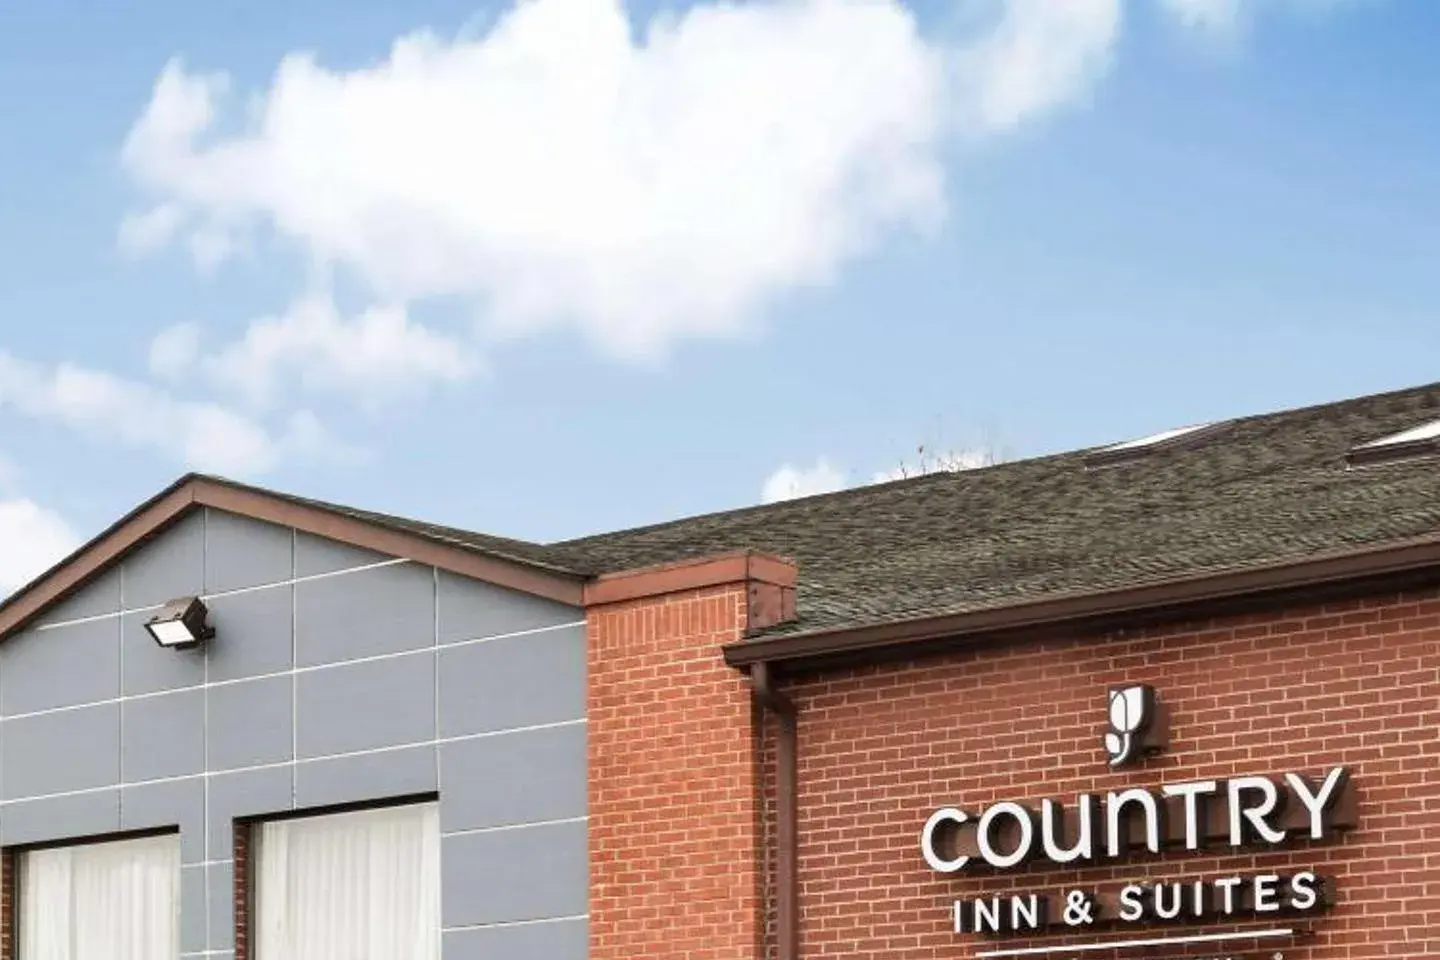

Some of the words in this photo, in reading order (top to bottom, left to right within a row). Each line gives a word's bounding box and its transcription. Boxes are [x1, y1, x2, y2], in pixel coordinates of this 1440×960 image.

[953, 894, 1039, 933] INN
[1063, 889, 1094, 926] &
[1120, 873, 1317, 921] SUITES
